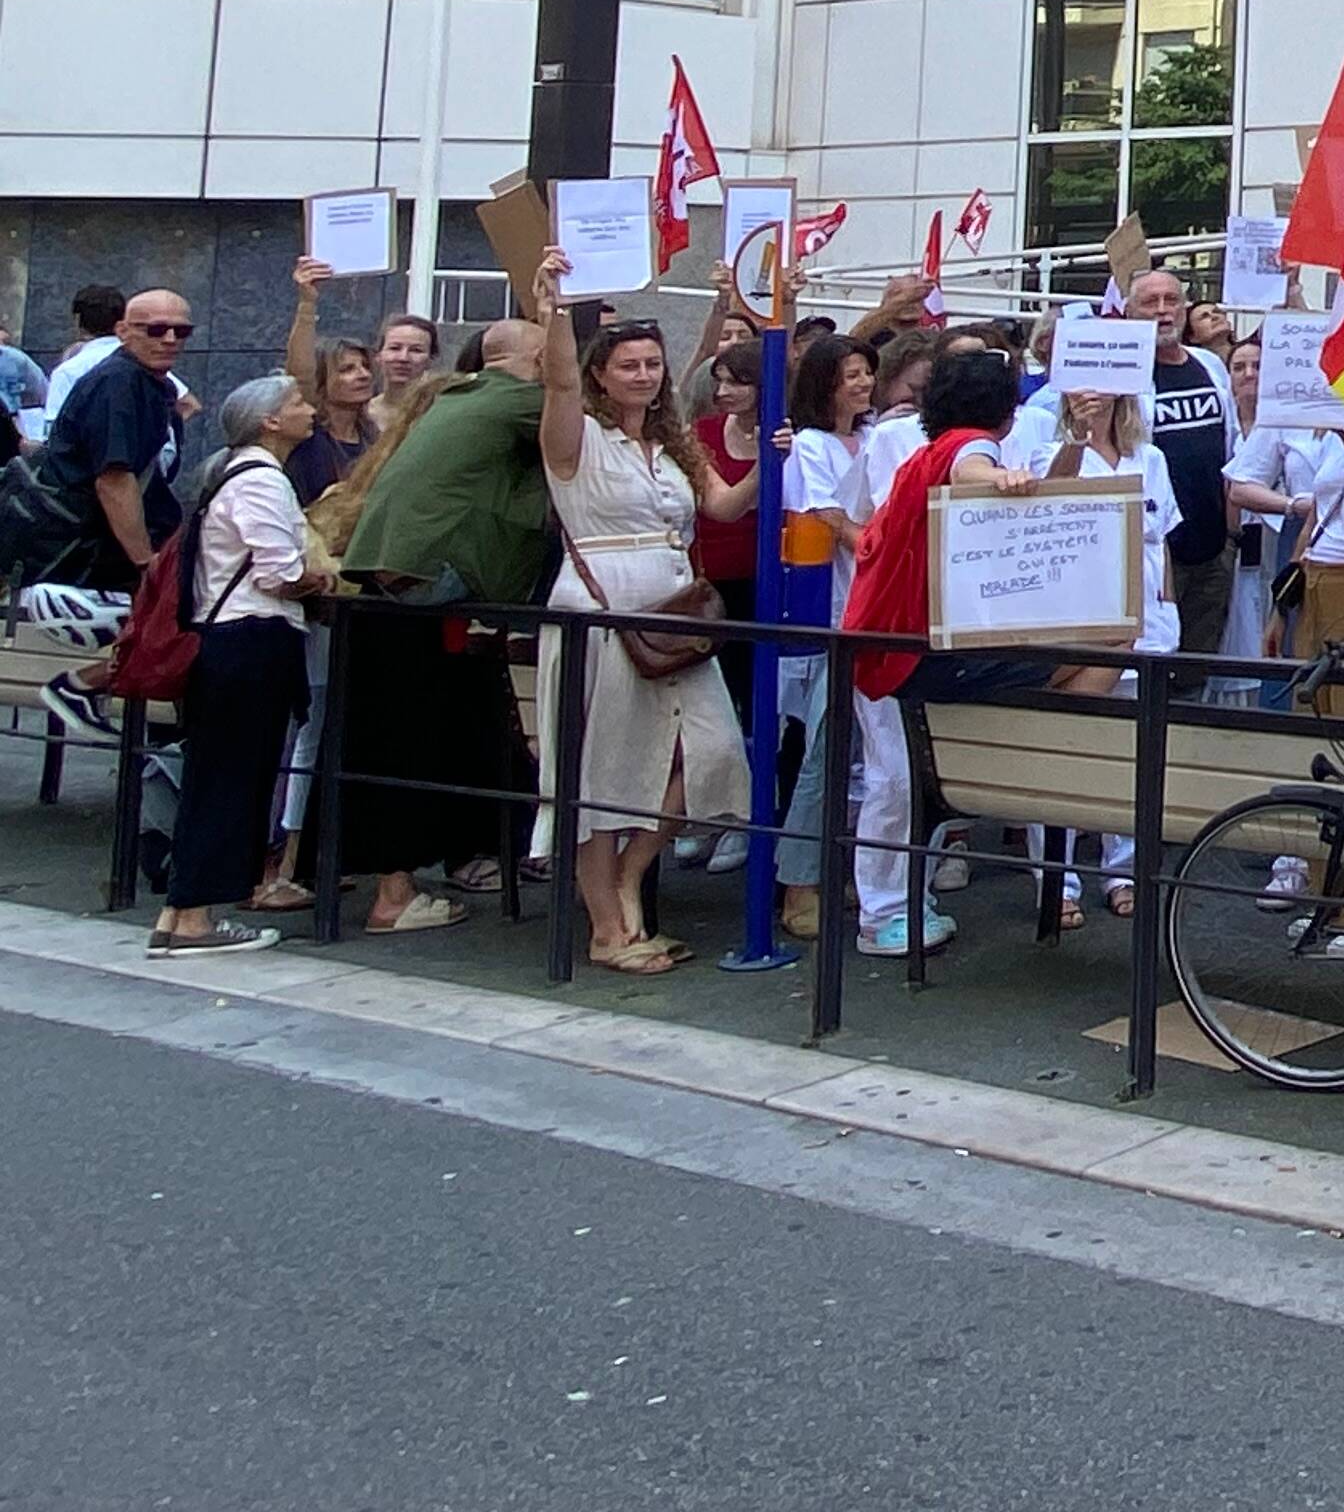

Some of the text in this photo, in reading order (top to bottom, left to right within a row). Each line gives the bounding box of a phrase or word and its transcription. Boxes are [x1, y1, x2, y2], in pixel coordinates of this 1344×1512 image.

[1155, 395, 1219, 423] NIN
[959, 506, 1018, 527] QUAND
[1024, 502, 1054, 519] LES
[998, 545, 1016, 558] LE
[1050, 554, 1079, 567] EST
